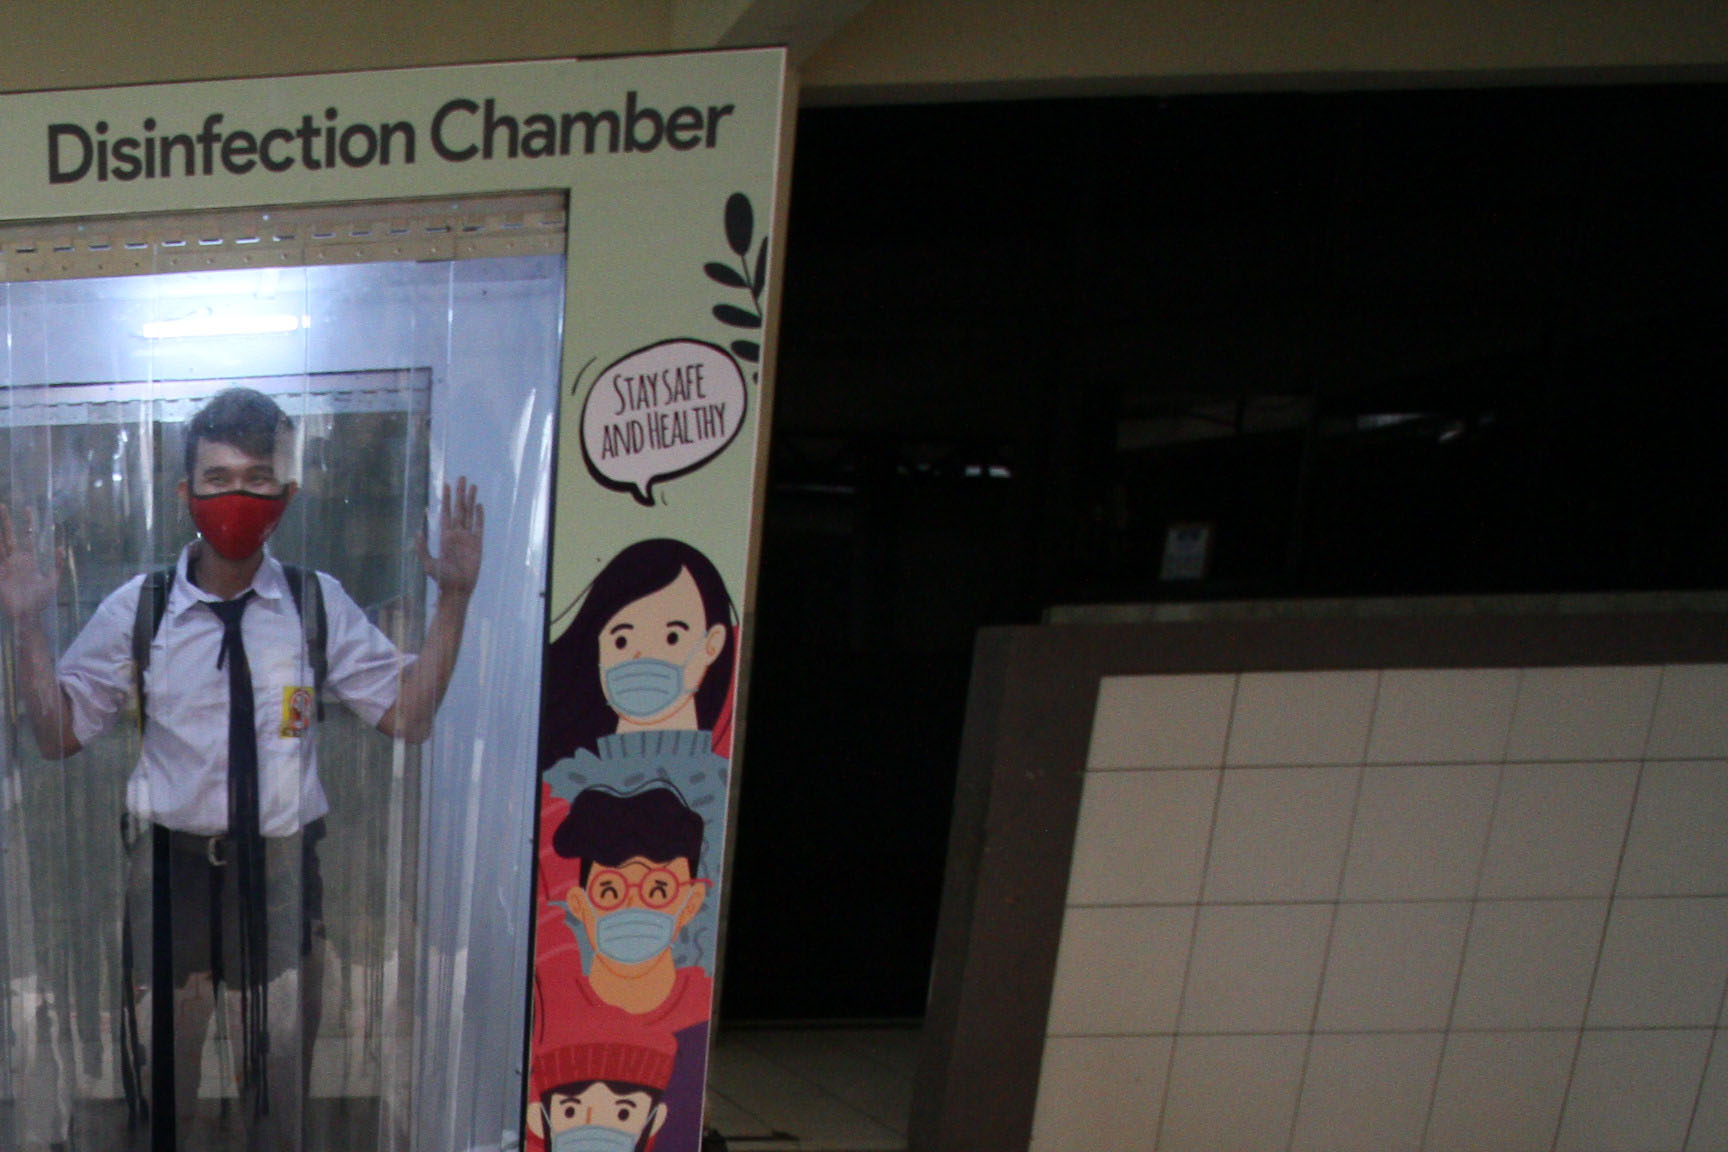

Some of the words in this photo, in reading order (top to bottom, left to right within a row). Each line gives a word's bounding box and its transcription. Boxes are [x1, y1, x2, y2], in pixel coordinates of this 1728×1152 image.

[47, 106, 416, 185] Disinfection
[430, 90, 736, 163] Chamber
[611, 371, 660, 416] STAY
[661, 363, 707, 406] SAFE
[601, 418, 645, 461] AND
[646, 401, 727, 451] HEALTHY
